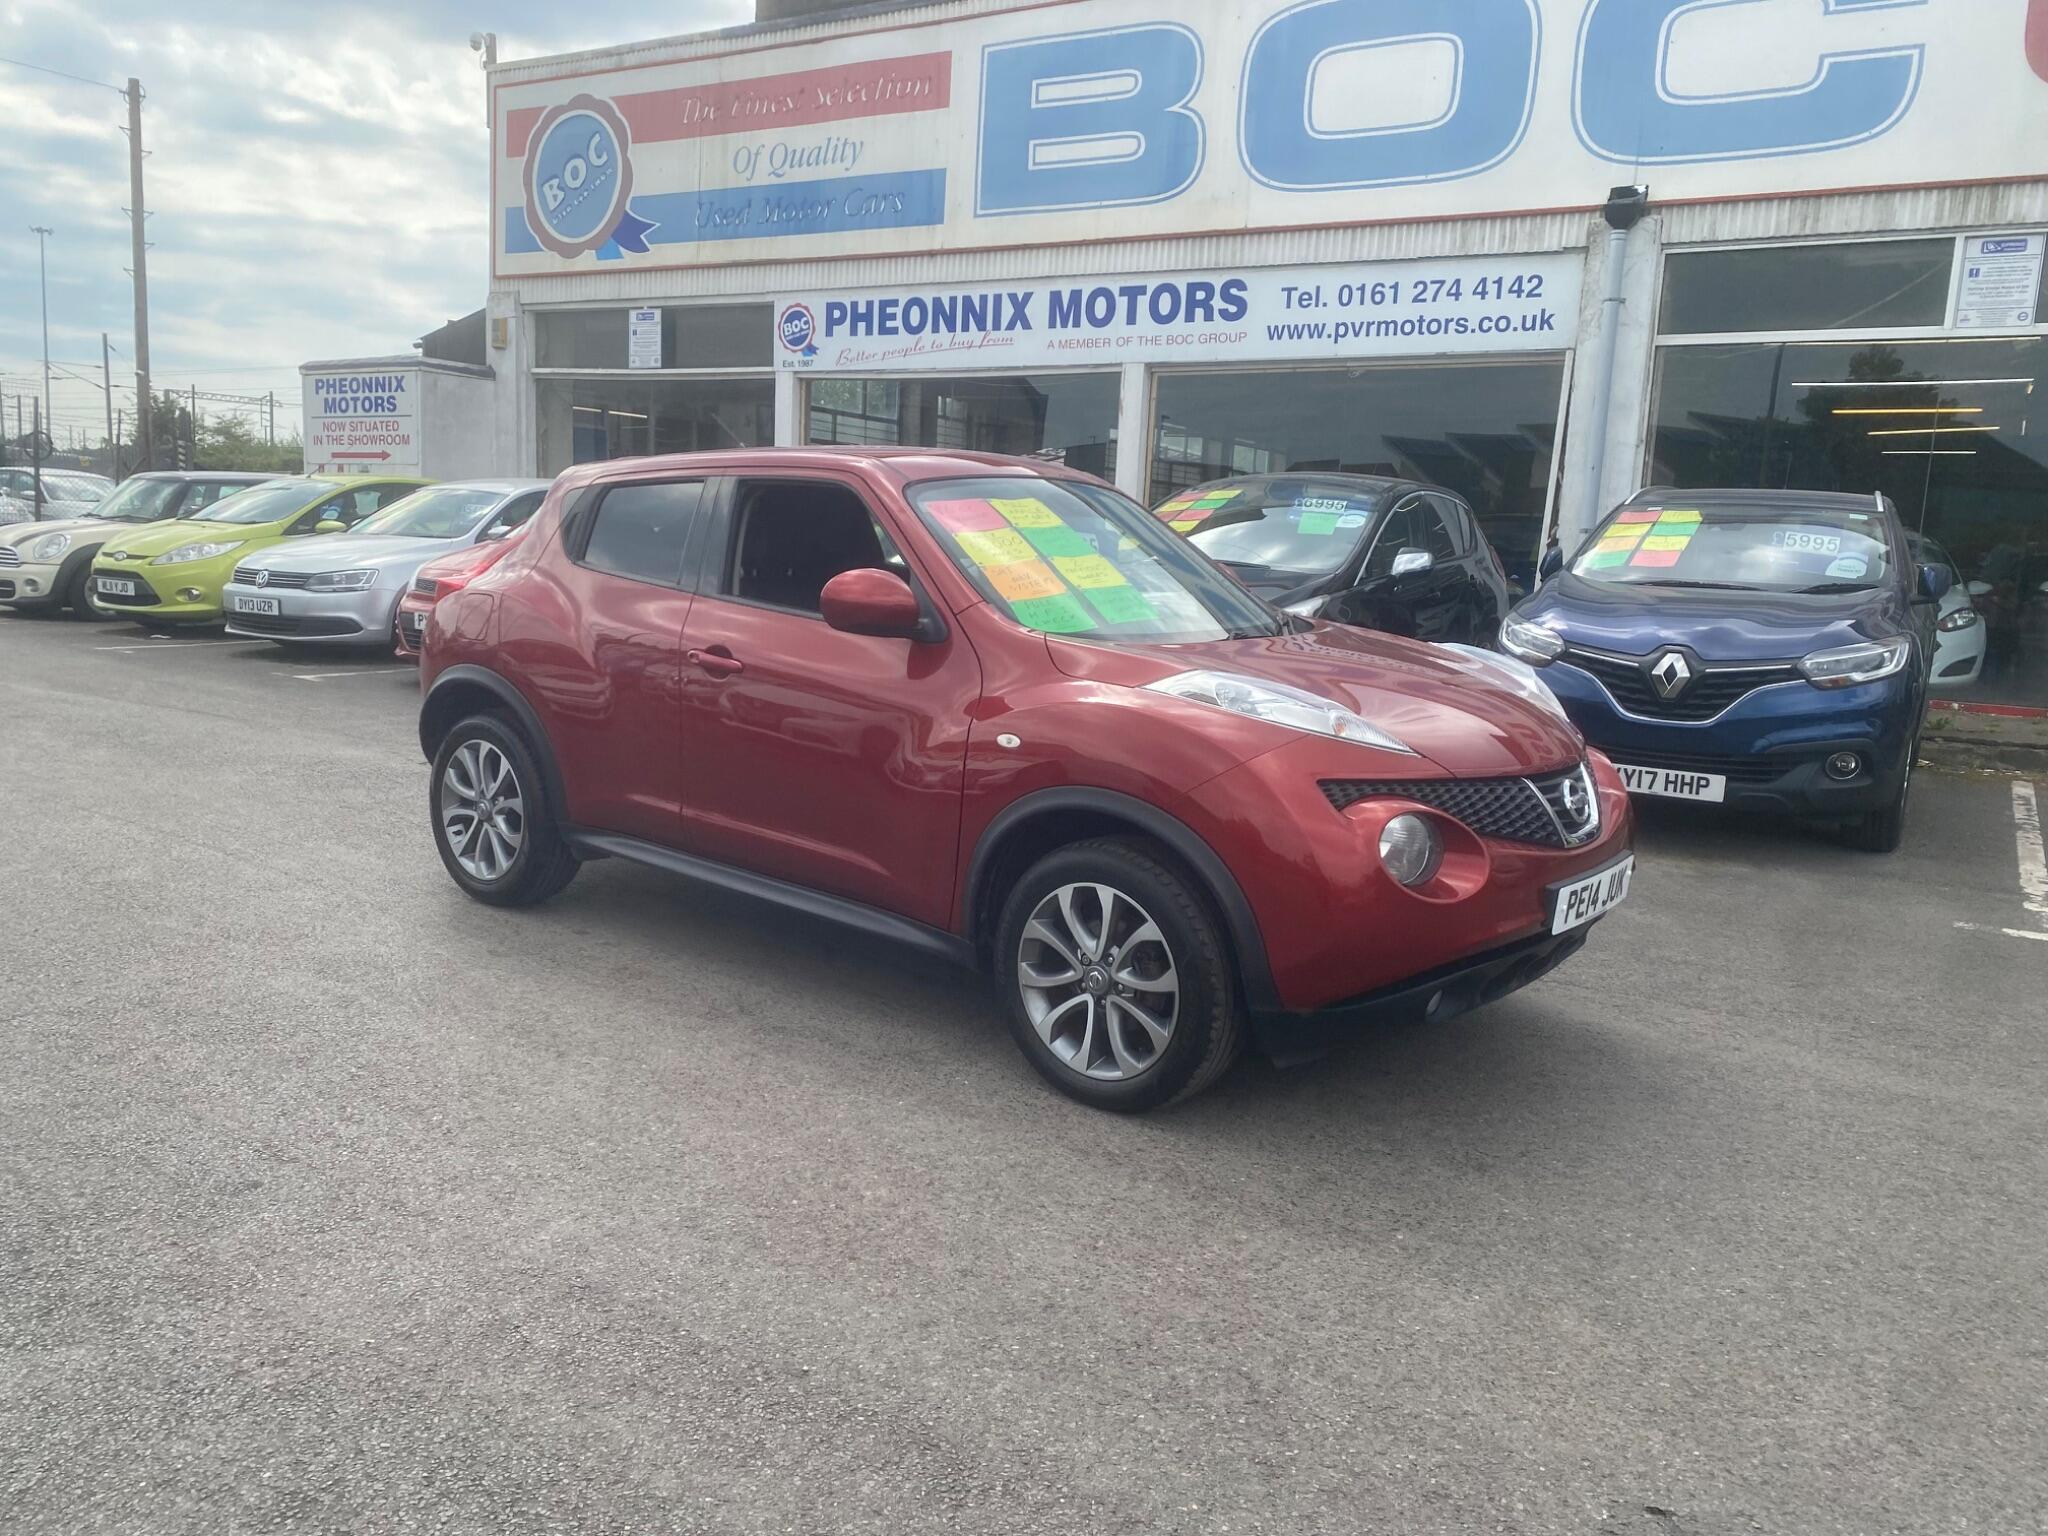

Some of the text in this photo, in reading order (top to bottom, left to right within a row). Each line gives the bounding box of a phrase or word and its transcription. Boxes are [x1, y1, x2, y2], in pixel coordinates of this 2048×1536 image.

[974, 0, 1926, 218] BOC
[542, 132, 609, 212] BOC
[733, 136, 864, 181] Of Quality
[695, 187, 905, 229] Used Motor Cars
[825, 278, 1248, 337] PHEONNIX MOTORS
[1281, 274, 1544, 310] Tel. 0161 274 4142
[783, 316, 809, 336] BOC
[1047, 331, 1248, 350] A MEMBER OF THE BOC GROUP
[1266, 308, 1556, 344] www.pvrmotors.co.uk
[835, 329, 1014, 367] Better people to buy from
[315, 375, 405, 395] PHEONNIX
[324, 395, 397, 414] MOTORS
[313, 433, 410, 446] IN THE SHOWROOM
[322, 420, 400, 433] NOW SITUATED
[239, 598, 272, 612] DY13 UZR
[1616, 767, 1710, 795] Y17 HHP
[1564, 864, 1628, 924] PE14 JUK
